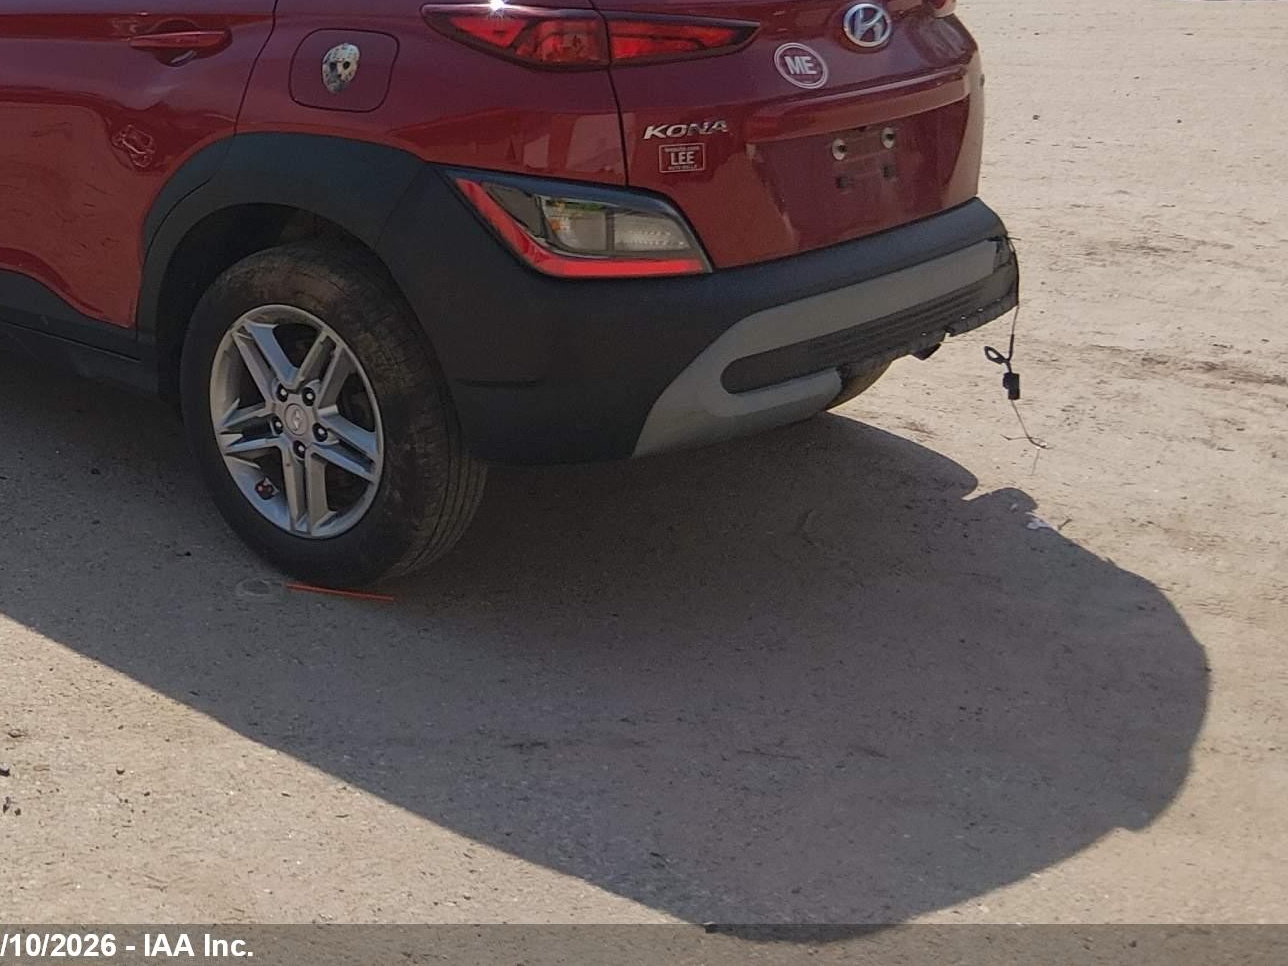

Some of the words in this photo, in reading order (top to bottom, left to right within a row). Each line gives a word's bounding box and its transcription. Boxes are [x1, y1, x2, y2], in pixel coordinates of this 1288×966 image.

[784, 55, 817, 75] ME
[643, 120, 729, 140] KONA
[670, 151, 696, 166] LEE
